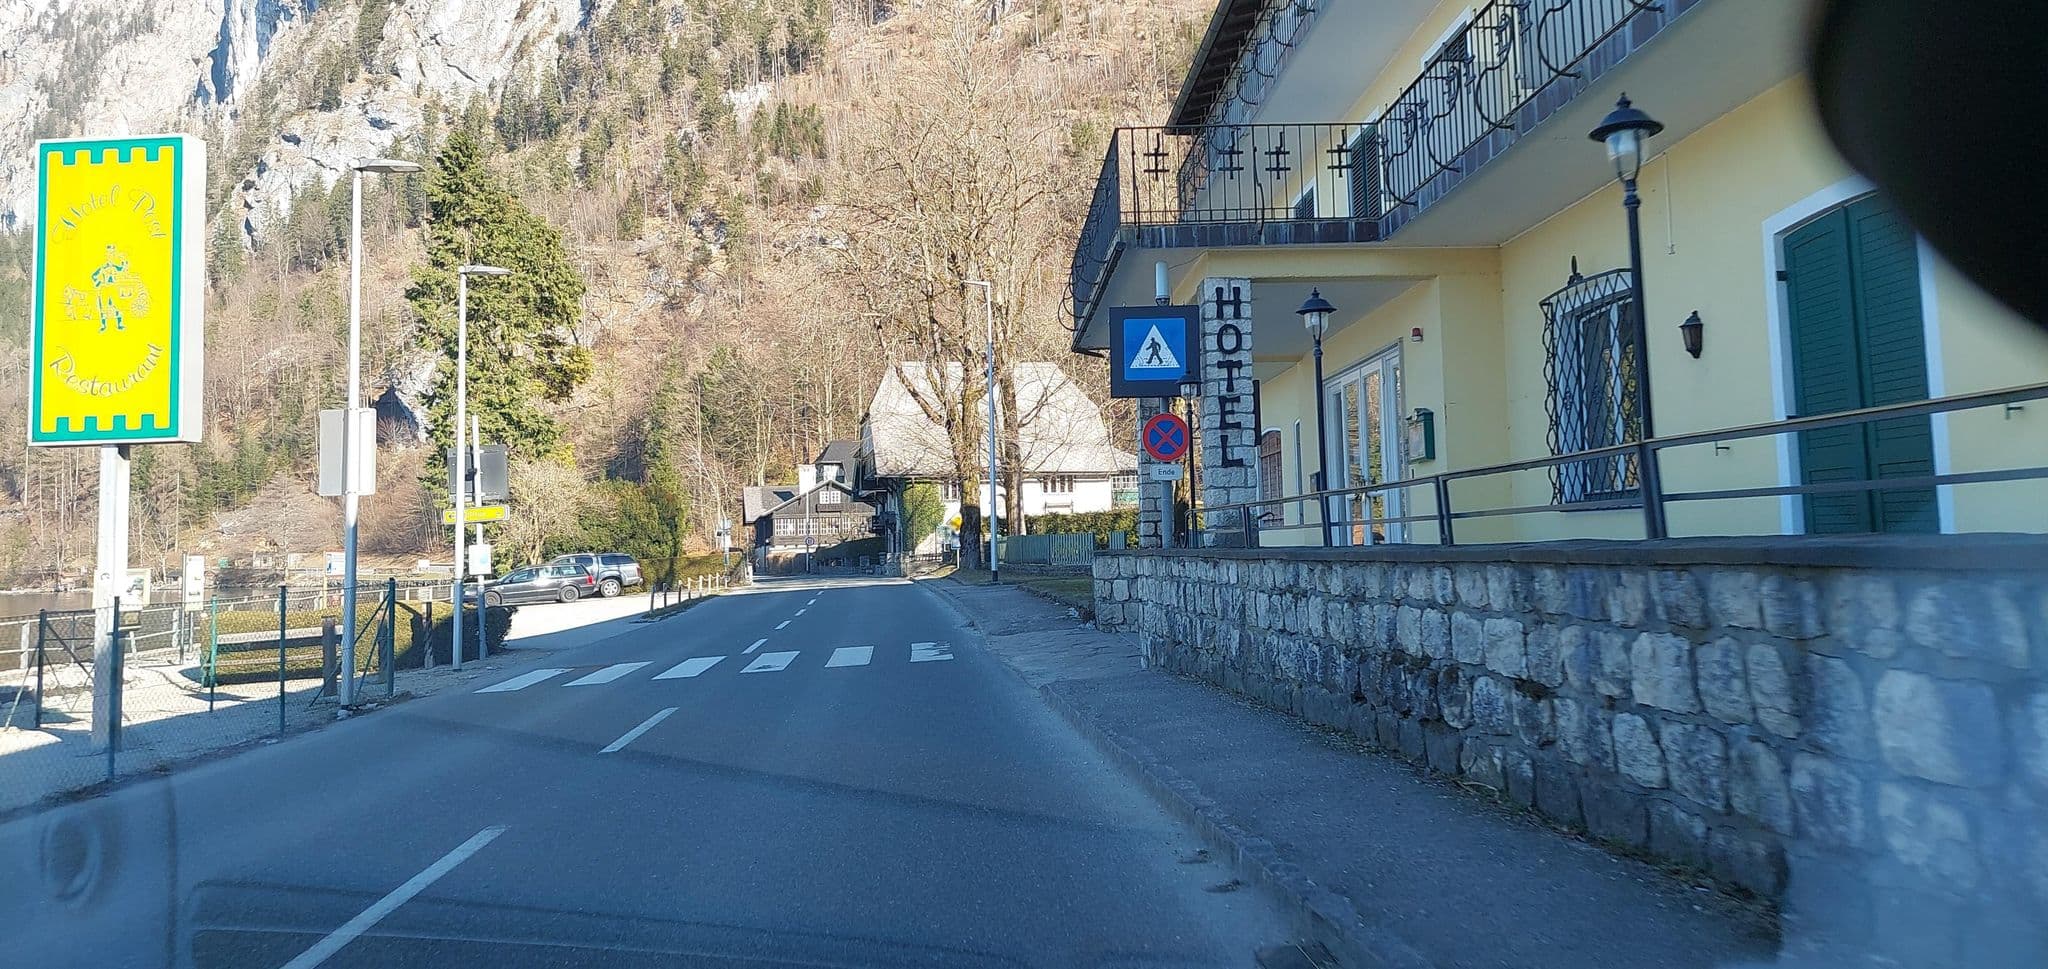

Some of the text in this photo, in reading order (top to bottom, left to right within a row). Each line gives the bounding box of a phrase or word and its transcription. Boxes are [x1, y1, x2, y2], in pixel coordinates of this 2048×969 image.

[50, 344, 162, 397] Restaurant
[1216, 287, 1243, 467] HOTEL
[1157, 468, 1176, 476] Ende
